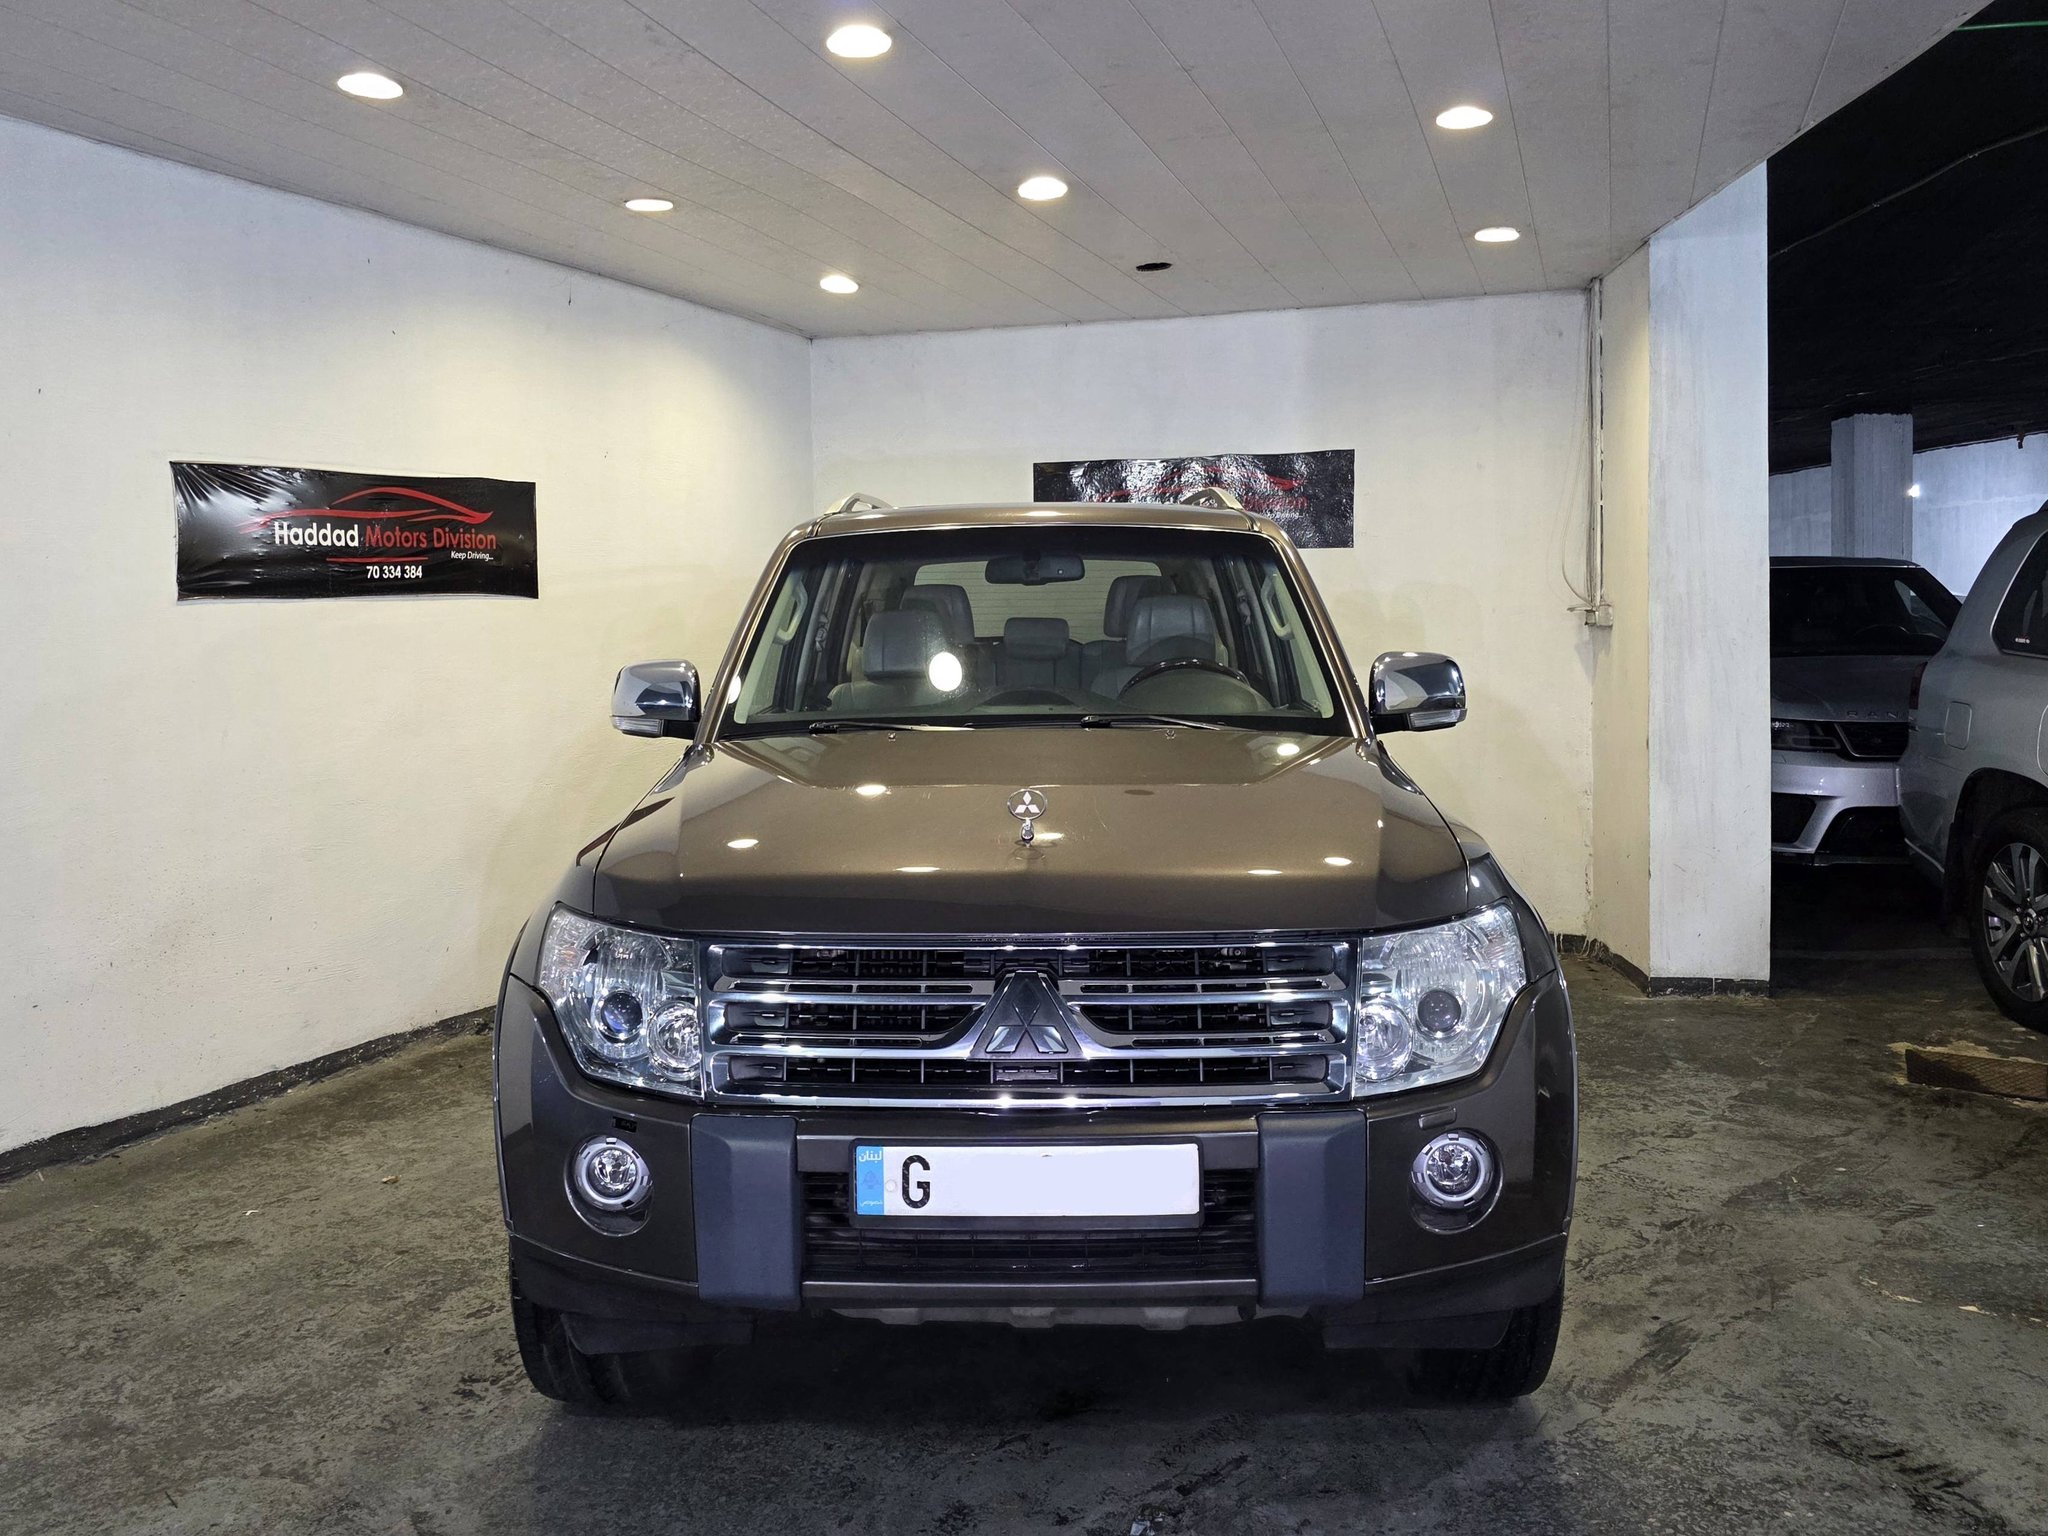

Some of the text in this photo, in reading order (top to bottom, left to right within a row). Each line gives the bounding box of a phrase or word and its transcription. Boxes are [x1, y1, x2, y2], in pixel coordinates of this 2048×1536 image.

[274, 521, 497, 549] Haddad Motors Division
[450, 550, 467, 560] Keep
[366, 565, 423, 579] 70 334 384
[858, 1150, 883, 1164] لبنان
[902, 1154, 931, 1209] G
